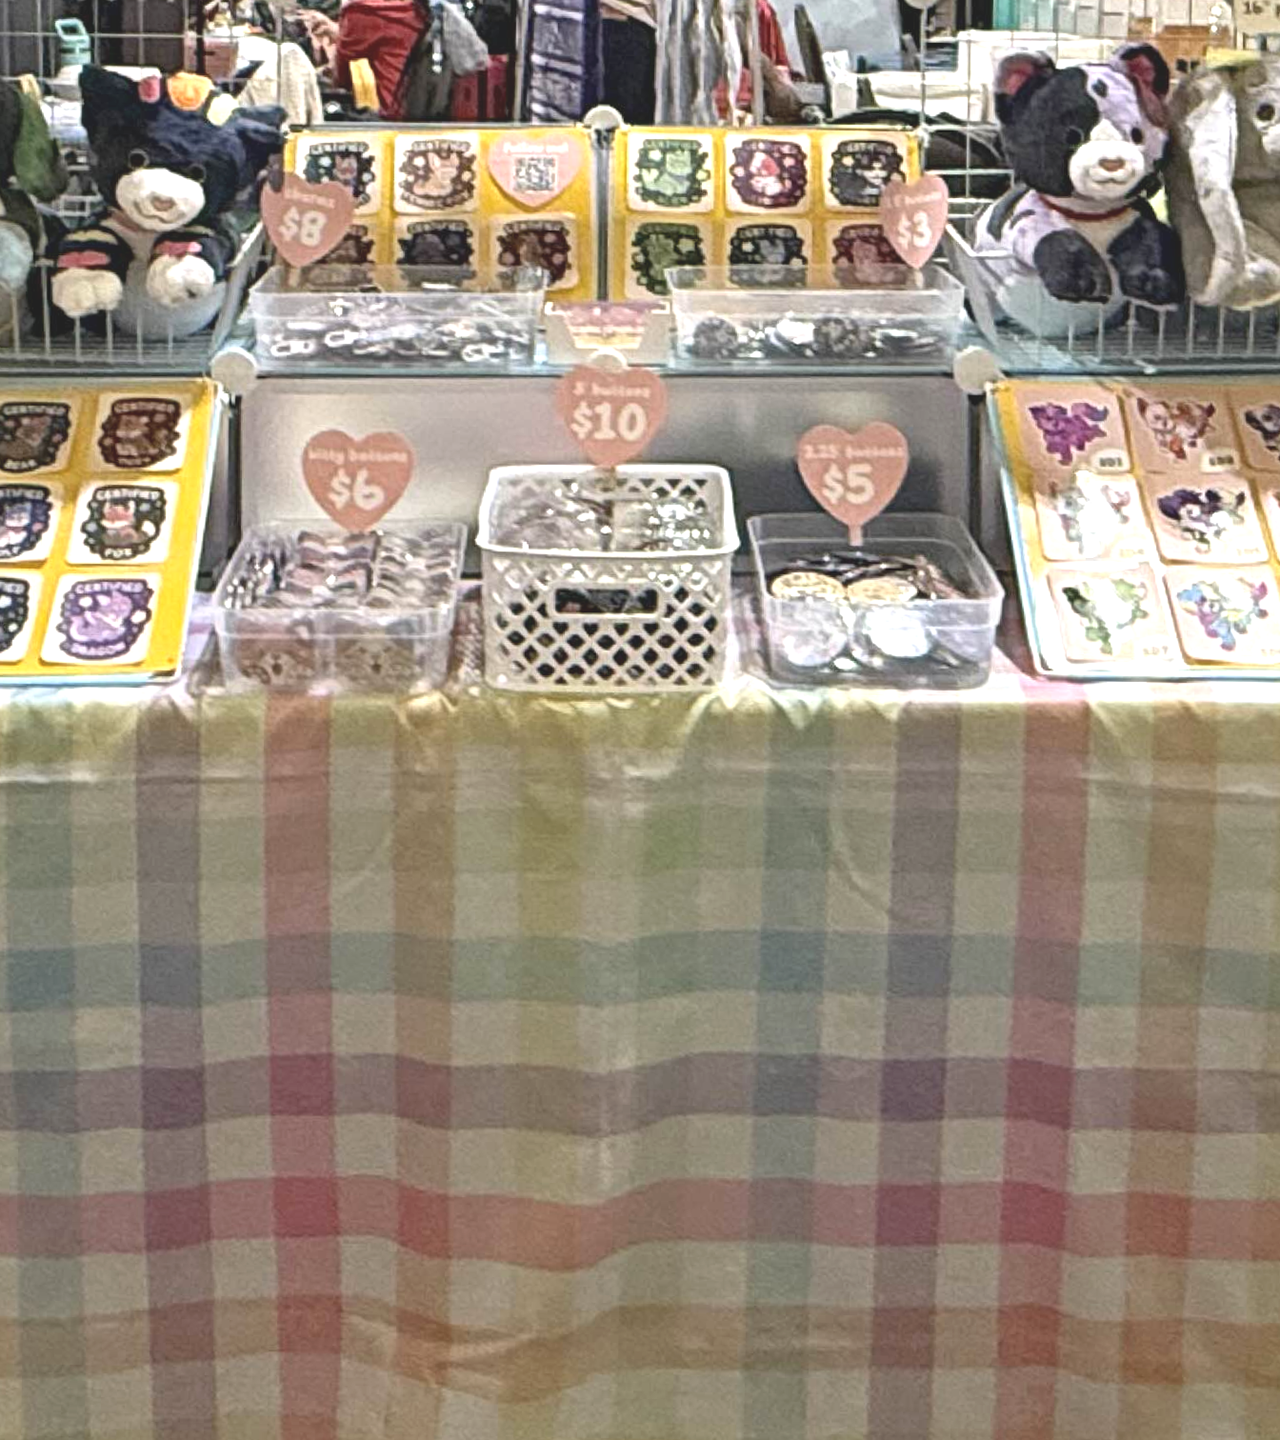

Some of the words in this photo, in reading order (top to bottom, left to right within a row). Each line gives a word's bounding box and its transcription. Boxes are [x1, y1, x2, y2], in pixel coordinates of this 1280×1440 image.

[279, 207, 328, 247] $8
[896, 211, 933, 250] $3
[569, 402, 648, 442] $10
[328, 468, 386, 512] $6
[822, 464, 874, 505] $5
